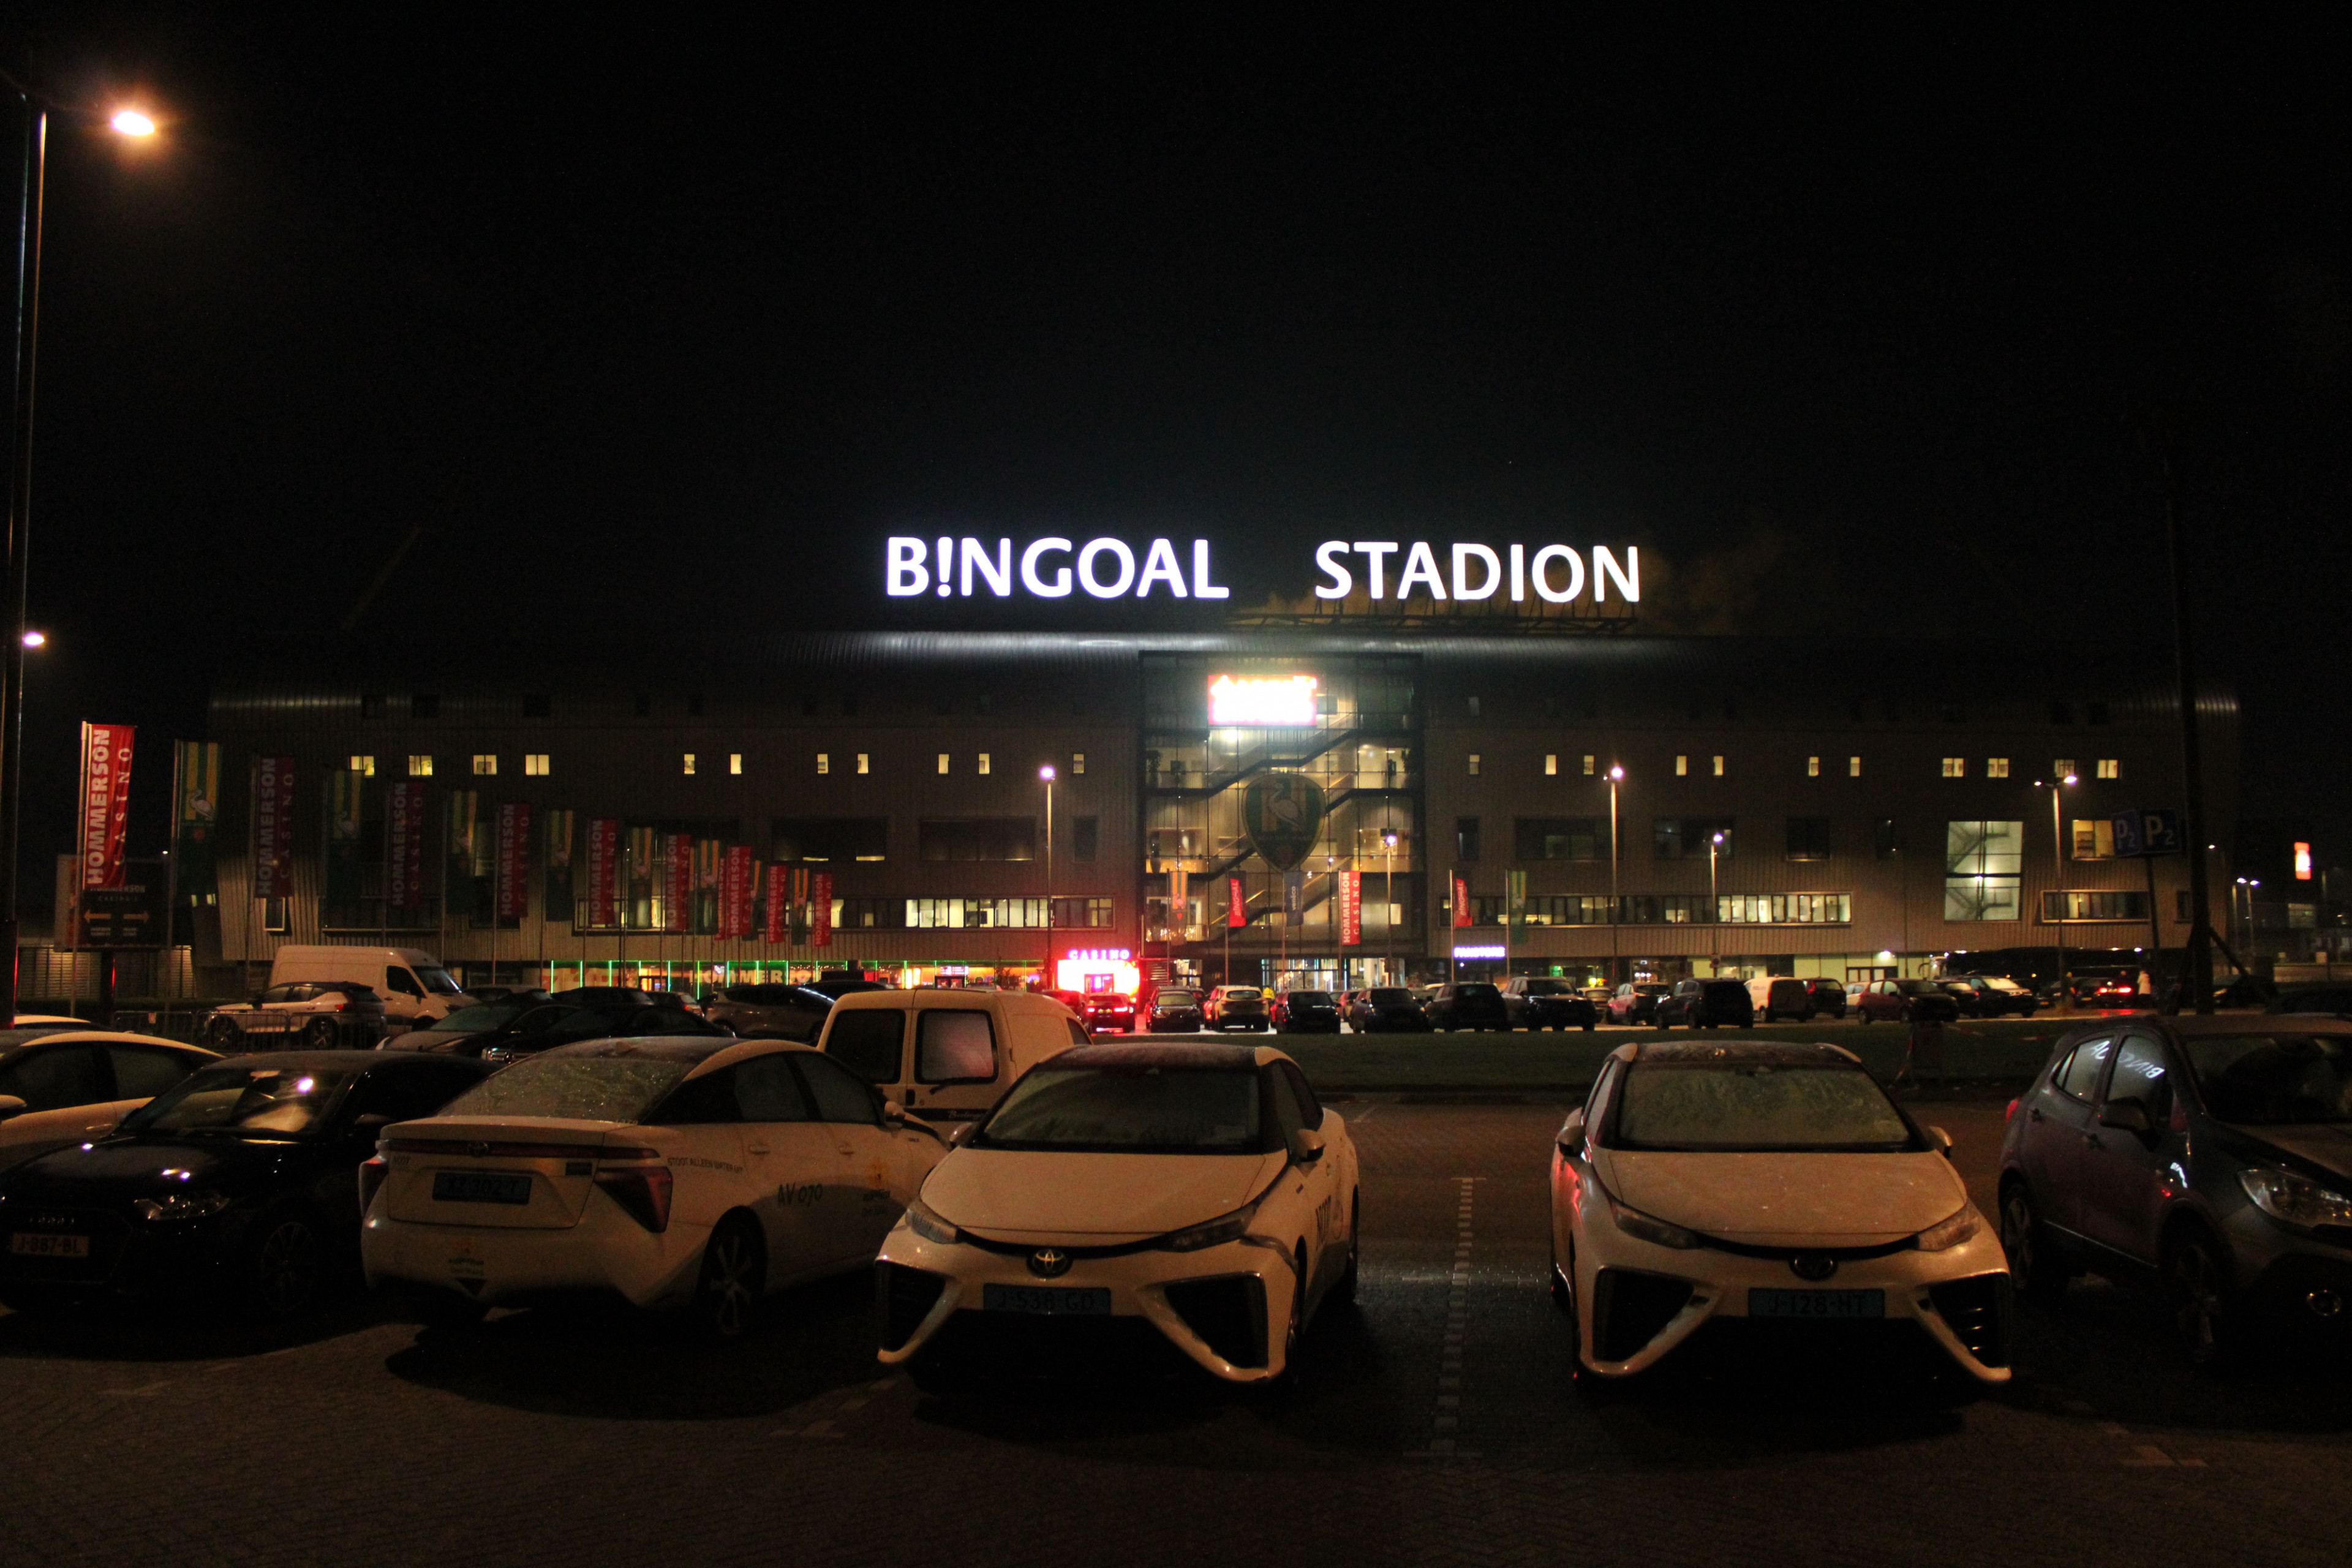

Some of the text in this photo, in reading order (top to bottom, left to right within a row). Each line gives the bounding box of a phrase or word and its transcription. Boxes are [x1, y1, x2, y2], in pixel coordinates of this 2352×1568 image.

[1315, 541, 1640, 603] STADION
[87, 729, 110, 884] HOMMERSON
[258, 758, 276, 894] HOMMERSON
[392, 783, 407, 905] HOMMERSON
[501, 804, 514, 915] HOMMERSON
[590, 820, 603, 922] HOMMERSON
[730, 846, 740, 934] HOMMERSON
[768, 866, 778, 941] HOMMERSON
[1341, 872, 1351, 943] HOMMERSON
[1069, 950, 1130, 960] CASINO
[668, 1157, 688, 1166] STOOT
